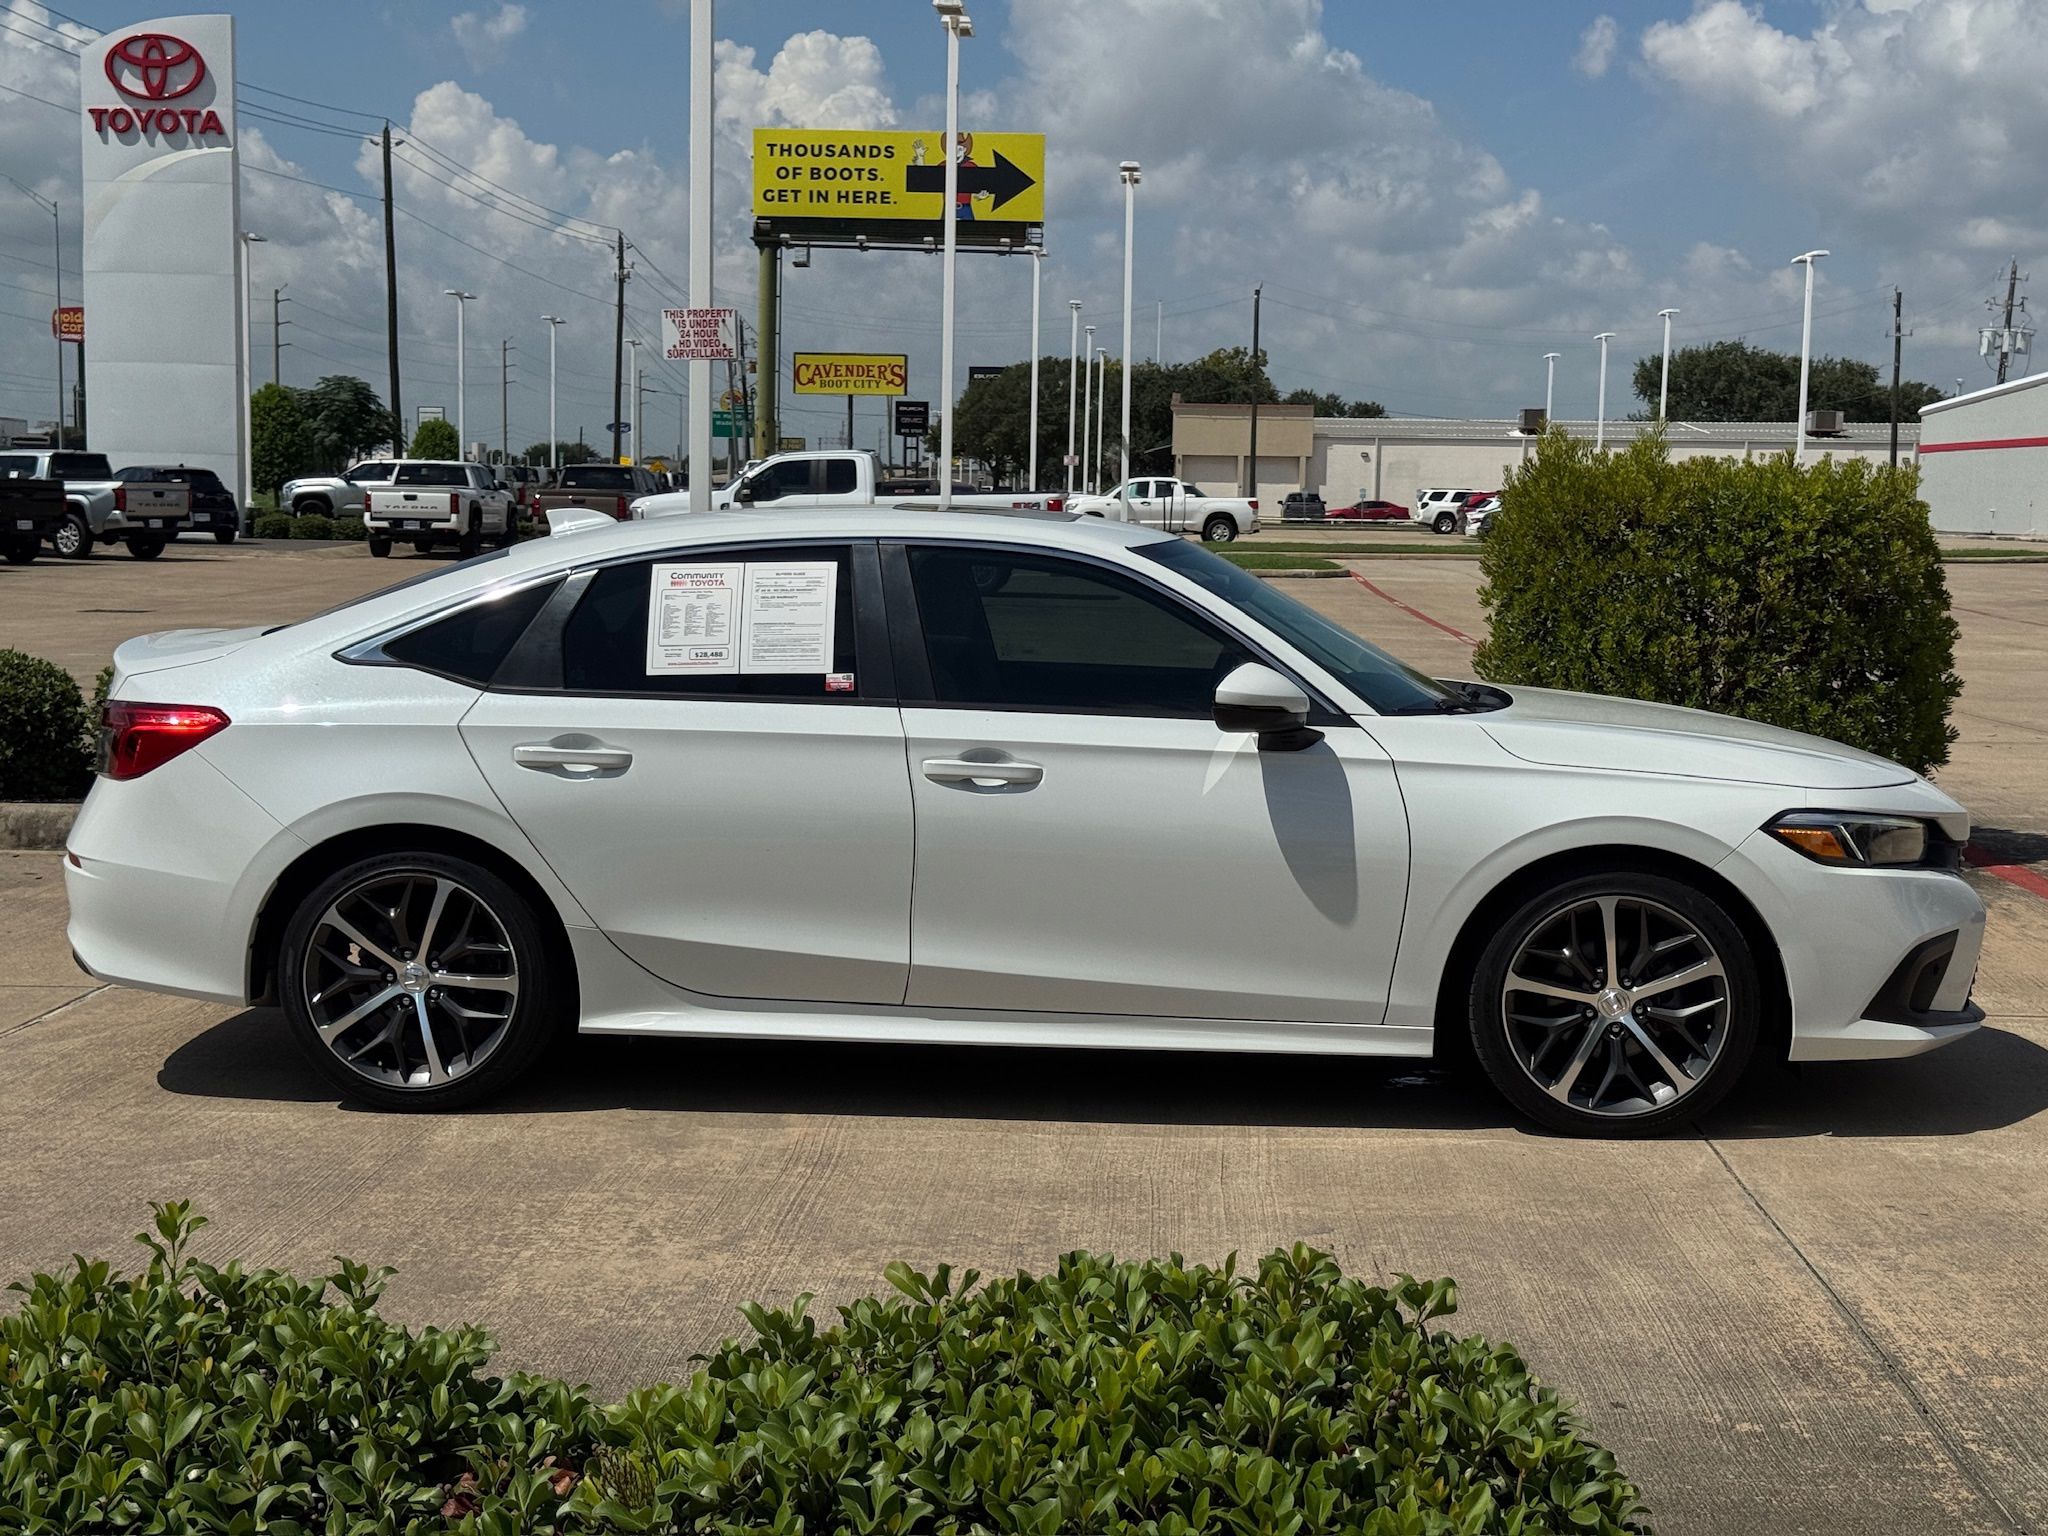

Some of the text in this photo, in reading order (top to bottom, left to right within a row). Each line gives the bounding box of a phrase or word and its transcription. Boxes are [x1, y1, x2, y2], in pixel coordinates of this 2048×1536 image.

[88, 107, 224, 135] TOYOTA
[766, 144, 895, 159] THOUSANDS
[776, 166, 884, 182] OF BOOTS.
[763, 189, 897, 205] GET IN HERE.
[663, 309, 734, 319] THIS PROPERTY
[678, 319, 720, 328] IS UNDER
[680, 329, 719, 338] 24 HOUR
[679, 339, 721, 348] HD VIDEO
[796, 362, 906, 387] CAVENDER'S
[819, 379, 882, 388] BOOT CITY
